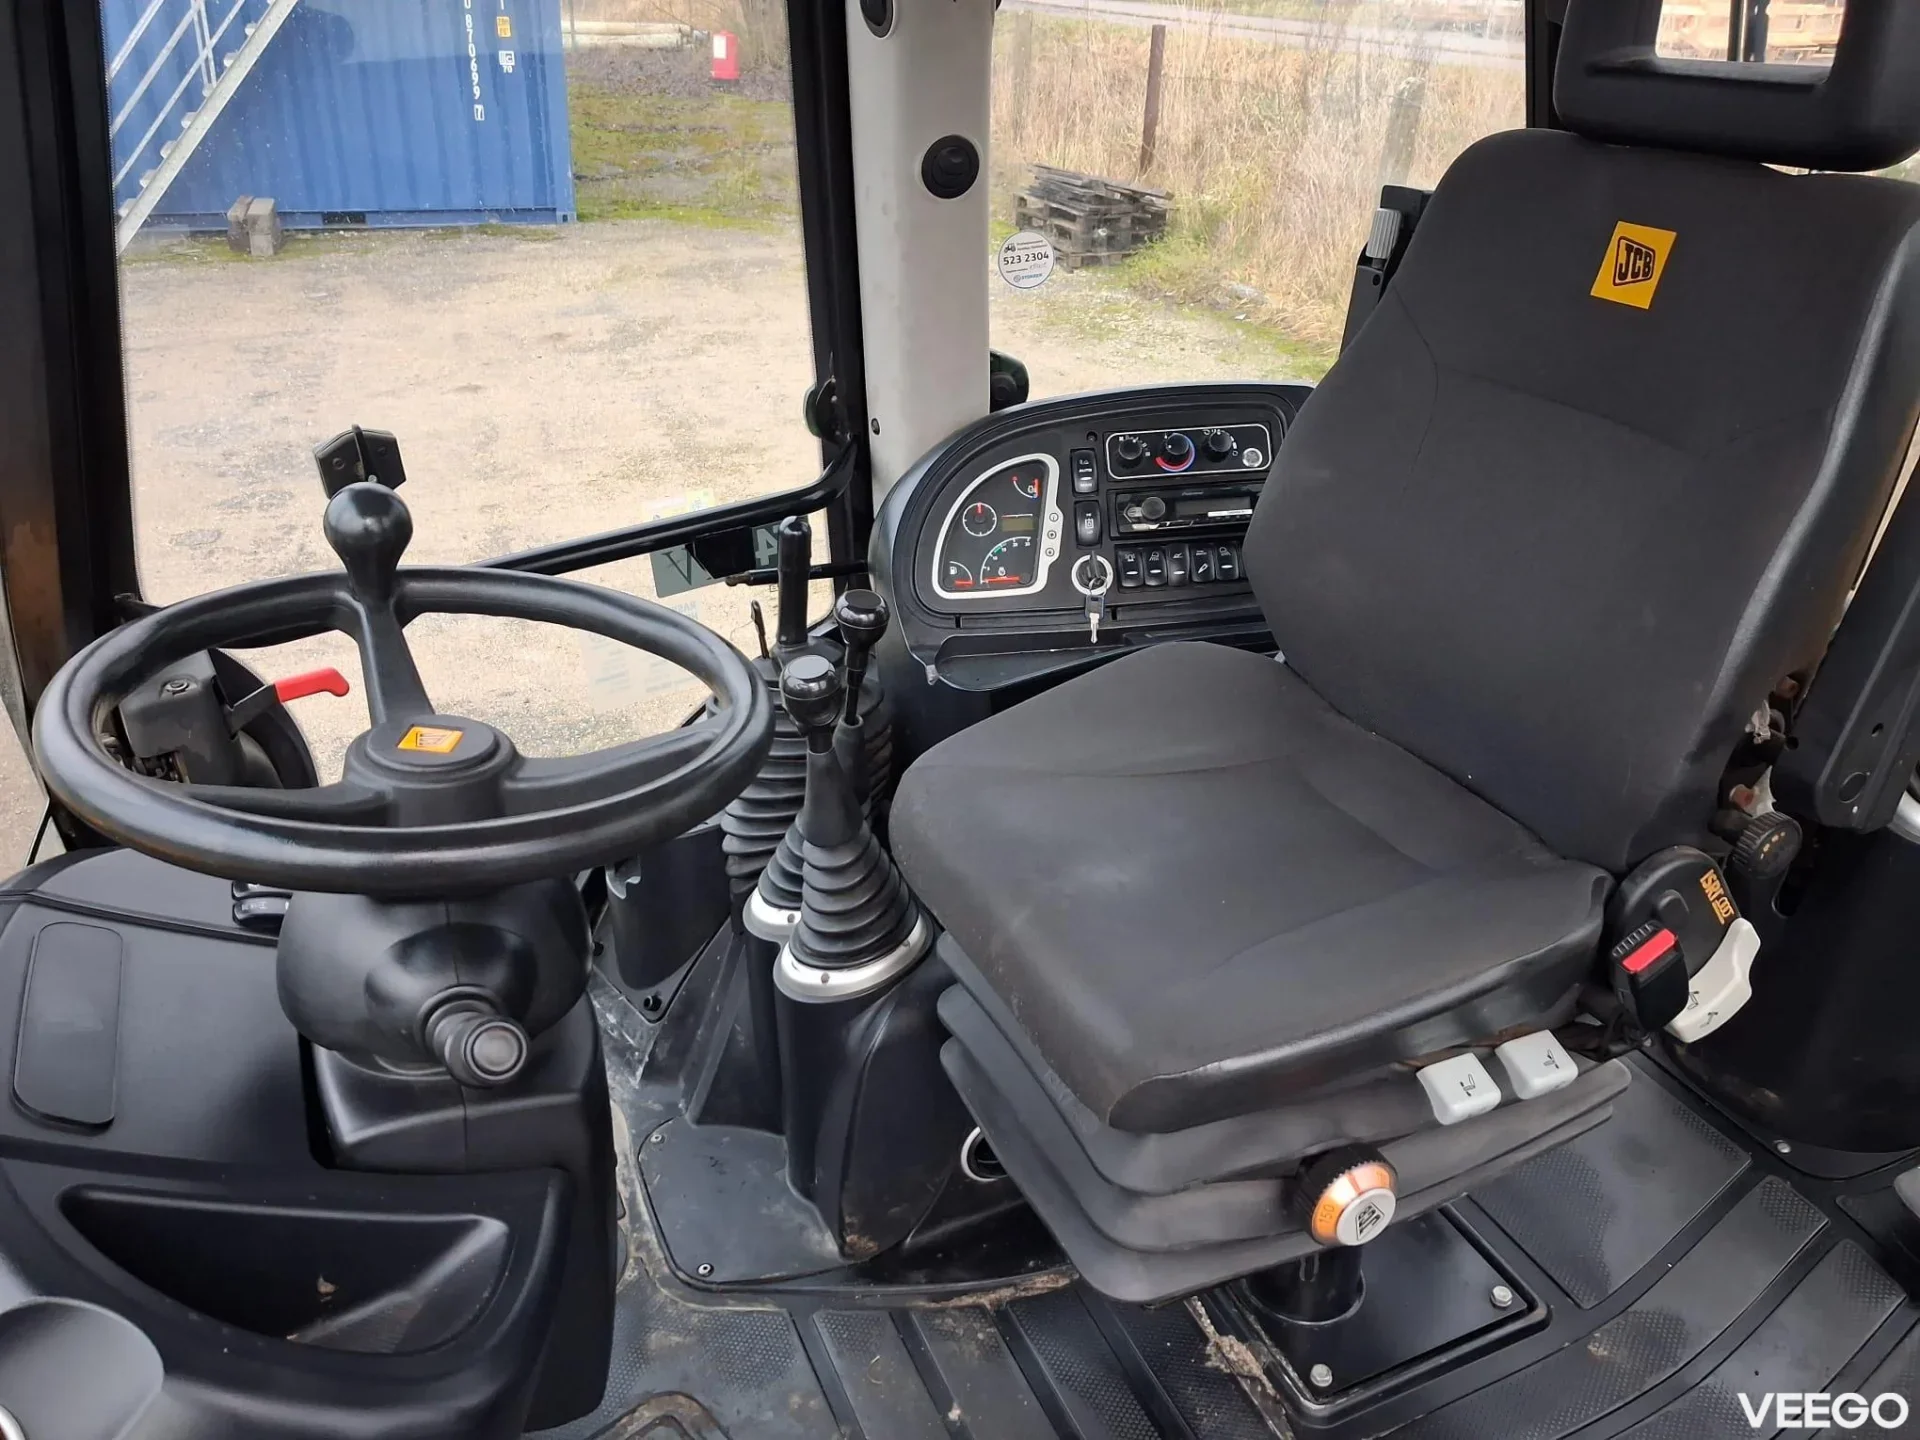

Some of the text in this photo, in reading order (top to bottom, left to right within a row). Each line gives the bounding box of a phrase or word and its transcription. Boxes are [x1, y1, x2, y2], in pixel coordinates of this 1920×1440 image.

[465, 14, 481, 100] 870699
[474, 104, 485, 121] 7
[1003, 255, 1022, 266] 523
[1024, 251, 1049, 263] 2304
[1617, 242, 1652, 281] JCB
[1319, 1204, 1335, 1224] 150
